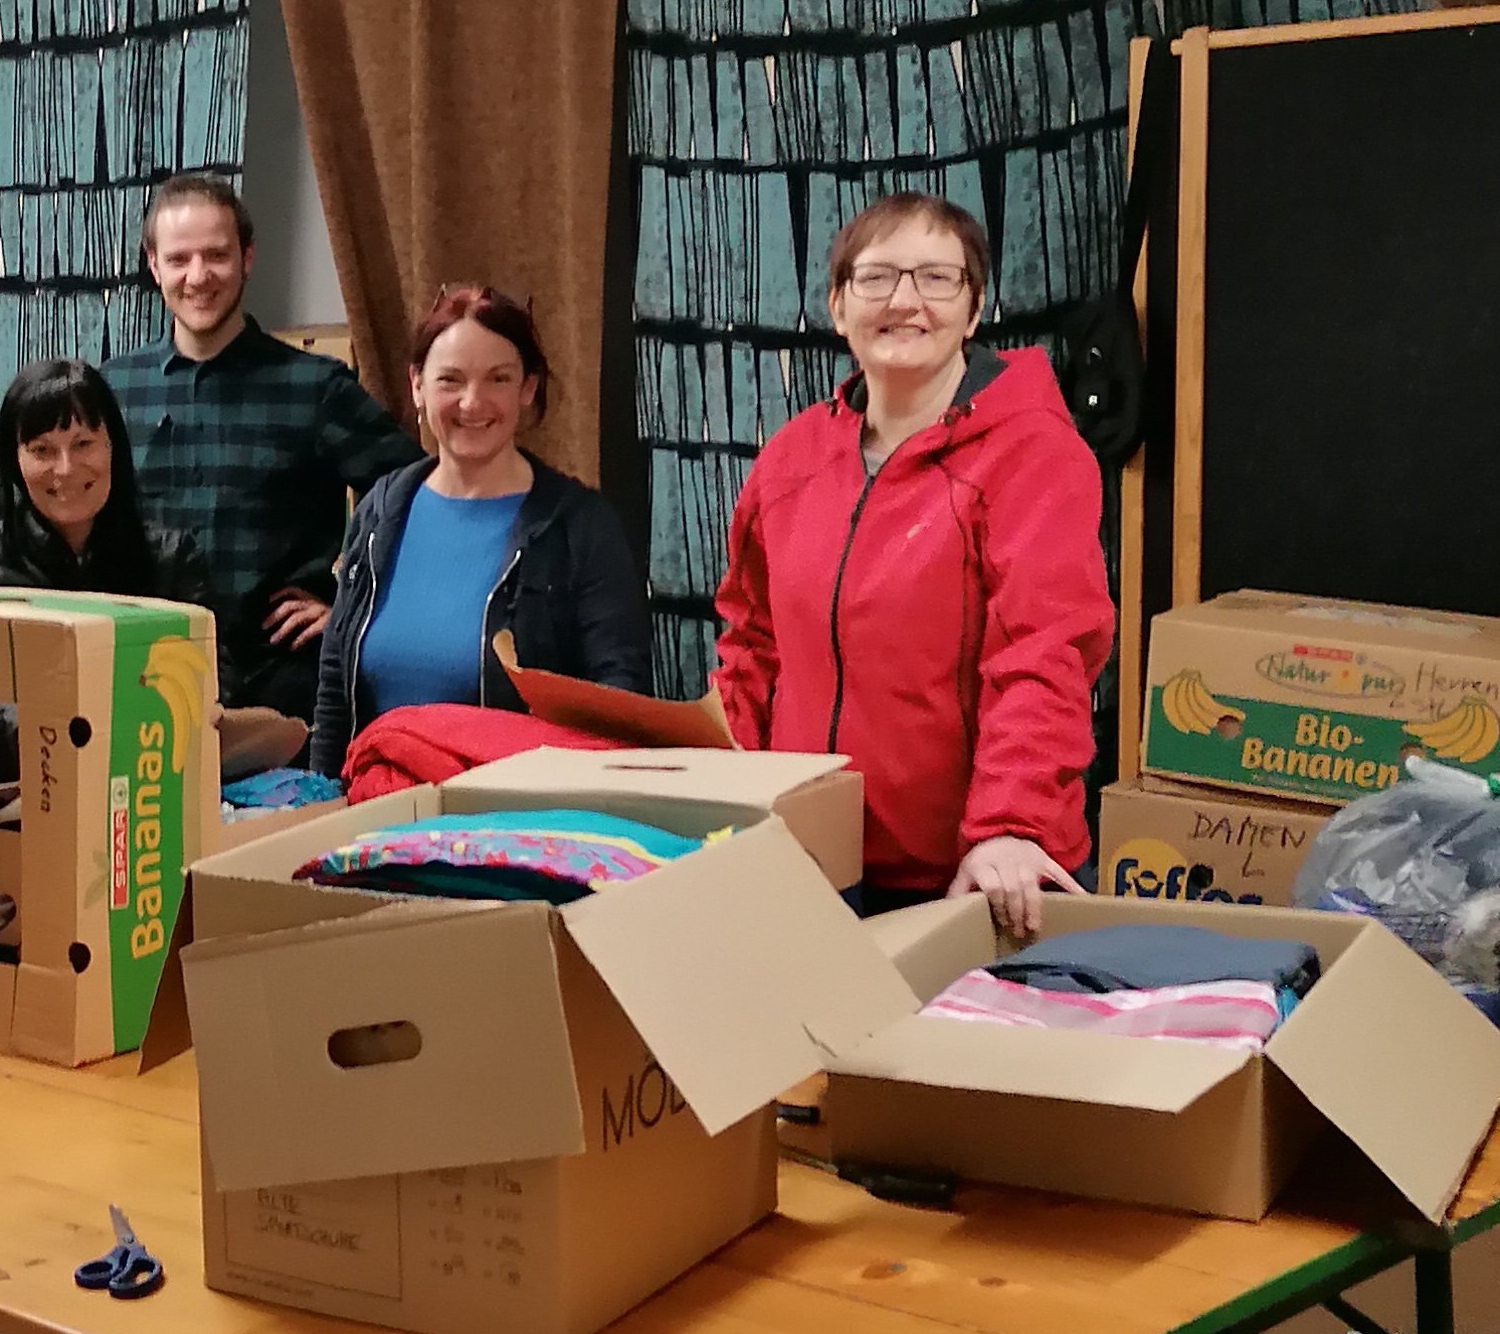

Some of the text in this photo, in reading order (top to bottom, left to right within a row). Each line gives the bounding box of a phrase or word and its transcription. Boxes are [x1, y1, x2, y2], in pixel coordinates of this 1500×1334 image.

[1266, 652, 1329, 683] Natur
[38, 724, 59, 813] Decken
[1241, 737, 1399, 789] Bananen
[115, 810, 126, 889] SPAR
[131, 720, 165, 960] Bananas
[1191, 811, 1307, 849] DAMEN
